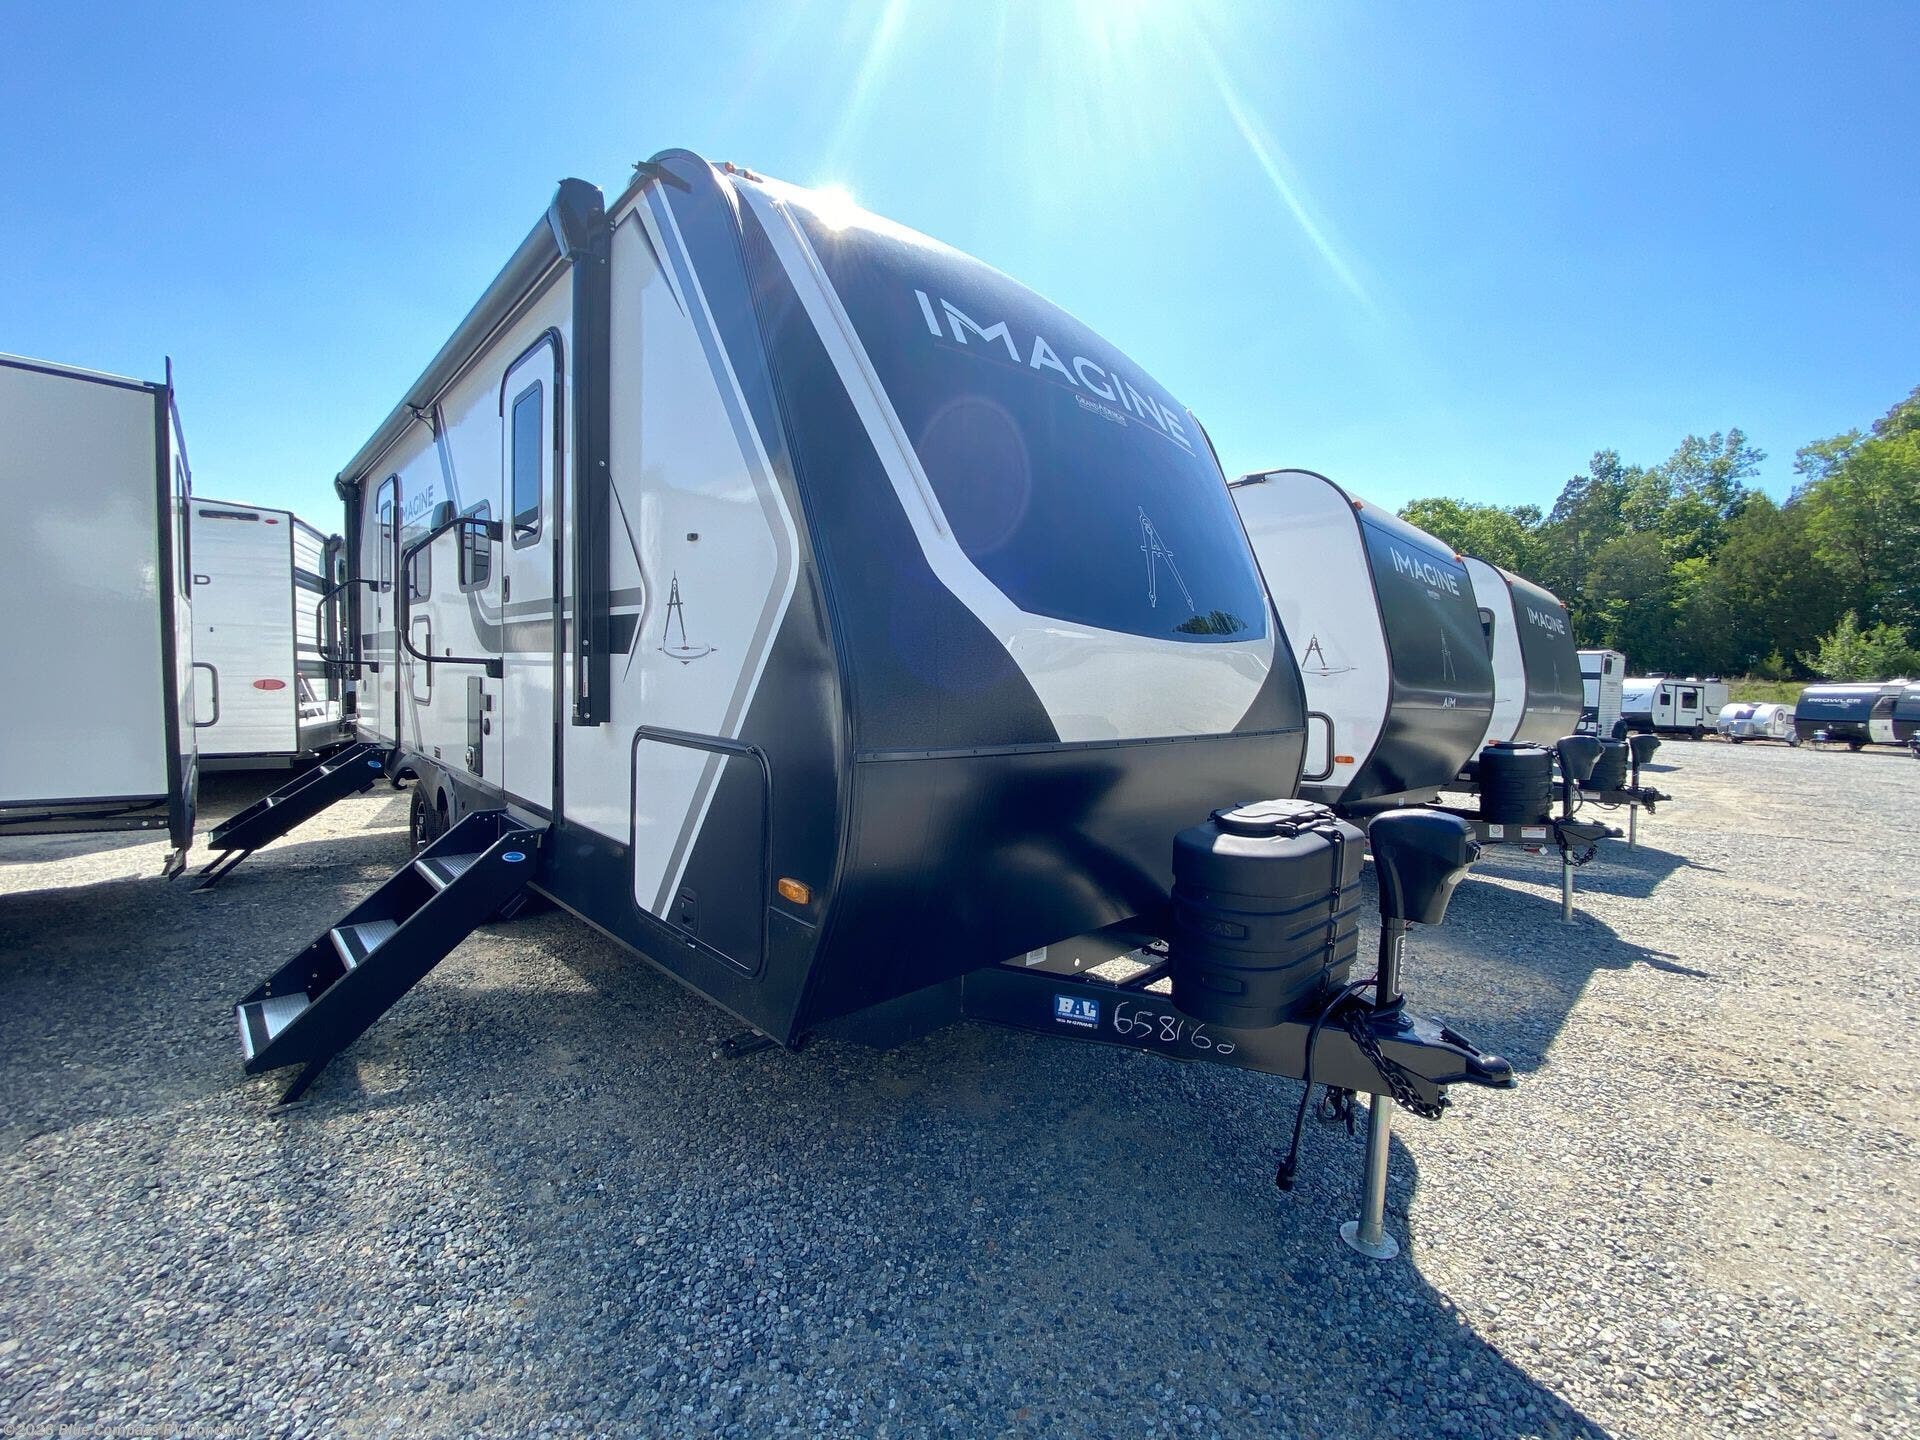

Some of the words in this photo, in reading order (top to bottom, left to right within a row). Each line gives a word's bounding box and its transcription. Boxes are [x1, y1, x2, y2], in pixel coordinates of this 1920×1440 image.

[913, 289, 1192, 448] IMAGINE
[401, 484, 434, 522] MAGINE
[1390, 546, 1461, 597] IMAGINE
[1526, 606, 1566, 635] IMAGINE
[1807, 697, 1862, 705] PROWLER
[1057, 997, 1097, 1018] BAL
